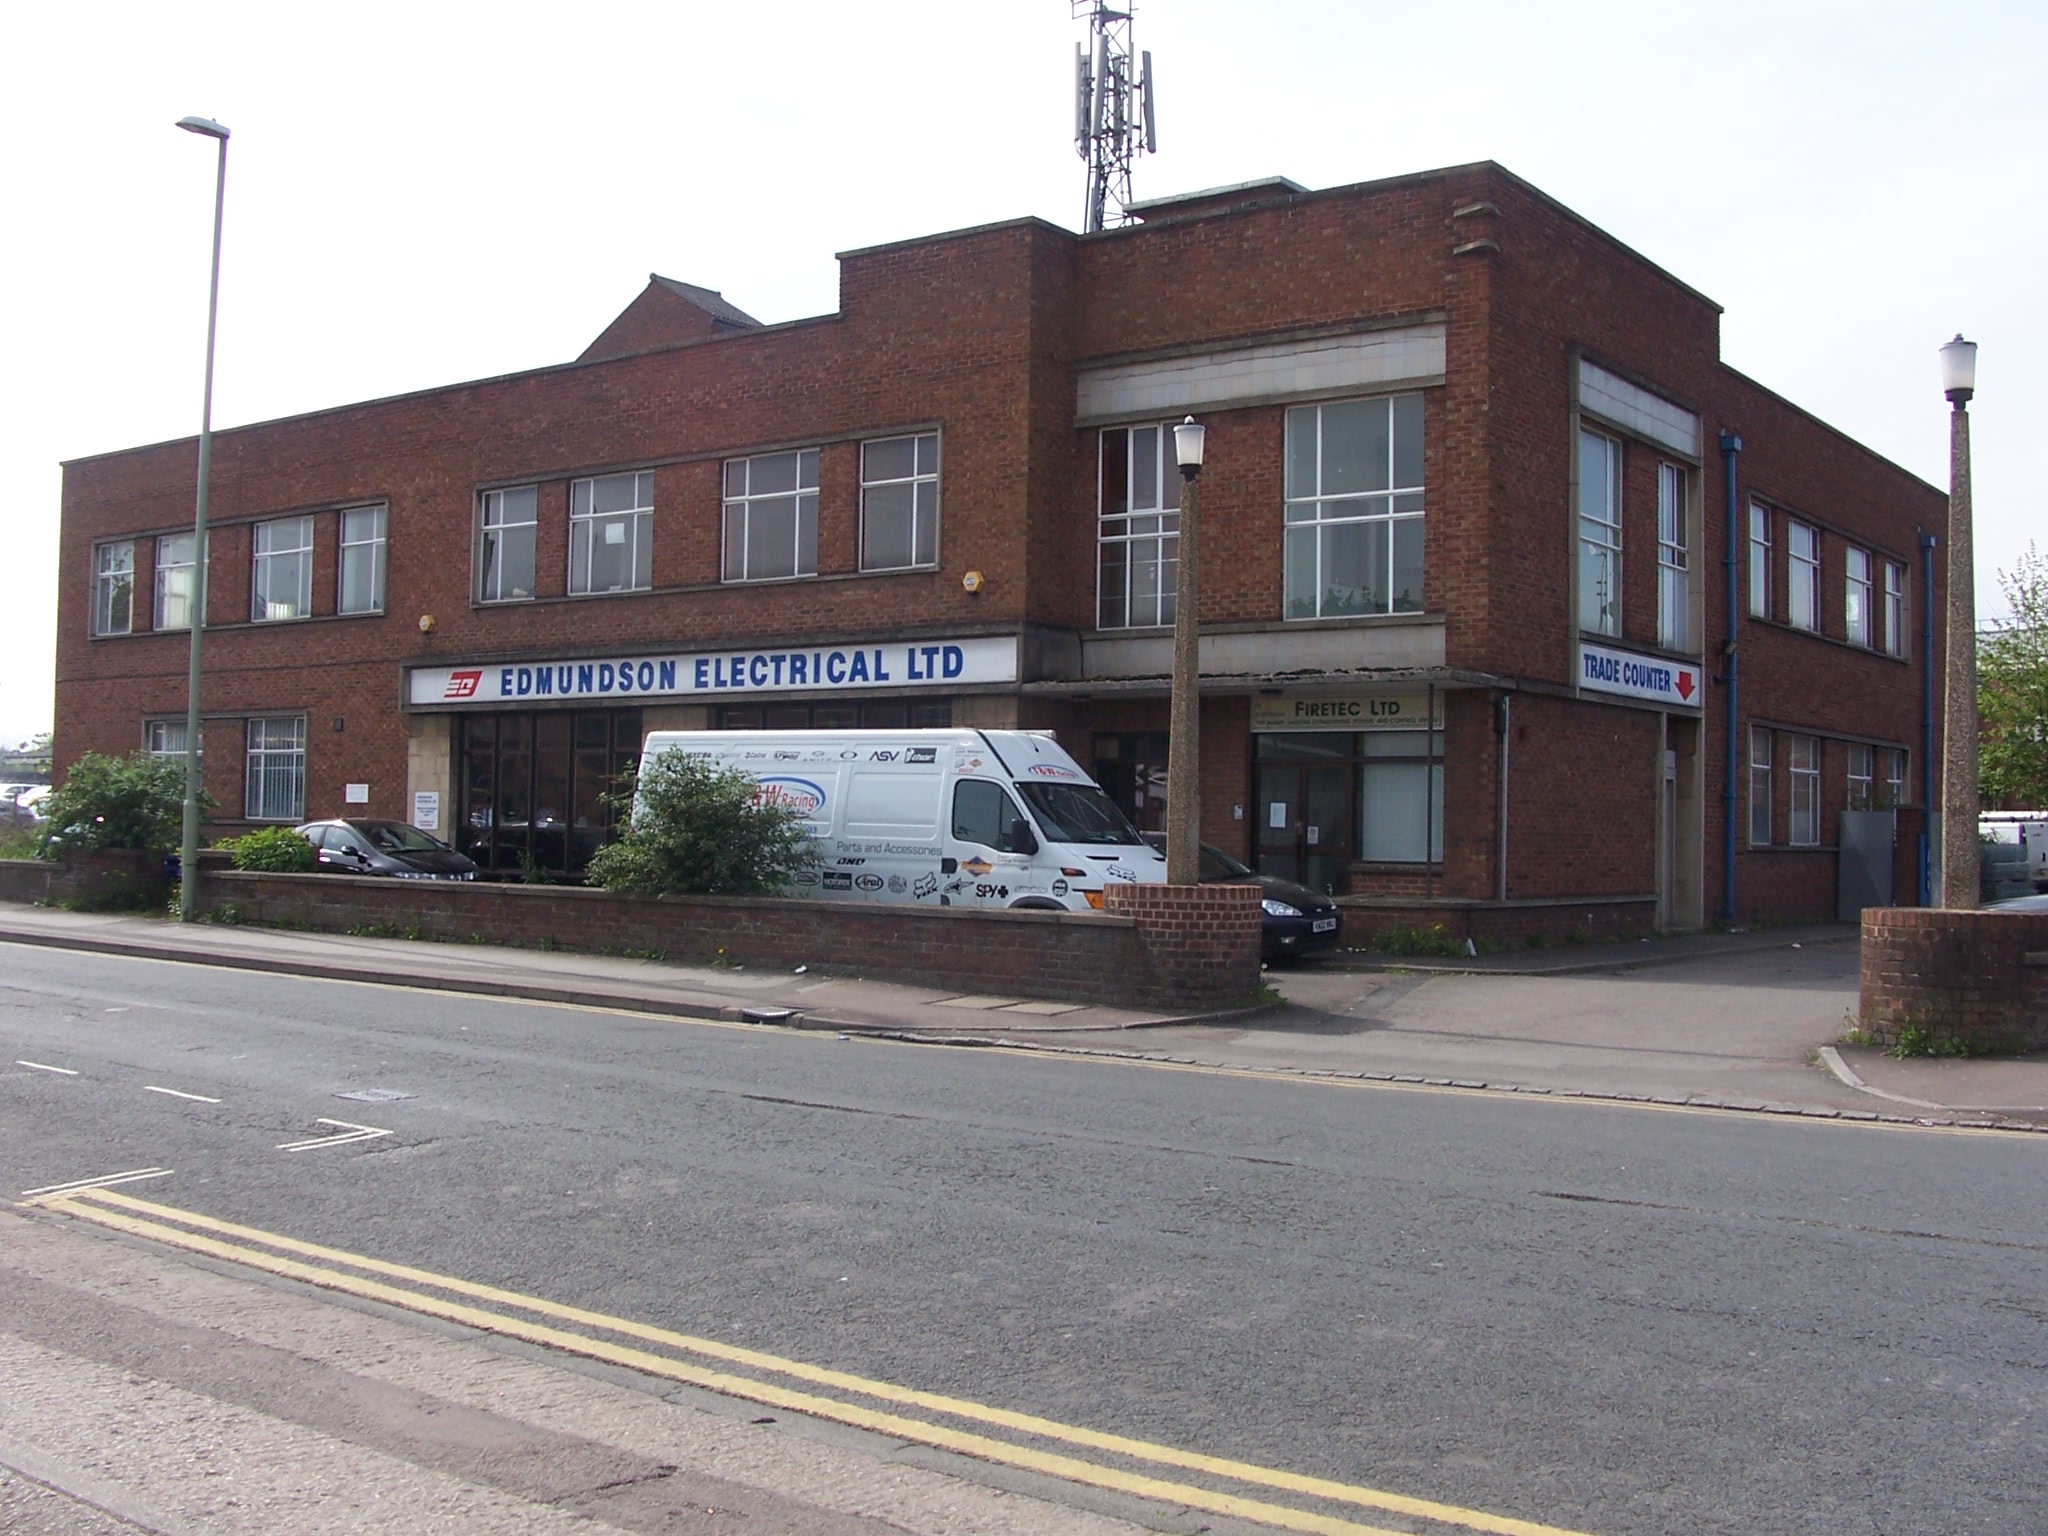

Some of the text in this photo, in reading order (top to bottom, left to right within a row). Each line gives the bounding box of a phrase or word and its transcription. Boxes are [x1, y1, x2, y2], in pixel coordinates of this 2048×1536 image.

[501, 645, 964, 696] EDMUNDSON ELECTRICAL LTD
[1583, 653, 1671, 693] TRADE COUNTER
[869, 751, 900, 762] ASV
[782, 792, 815, 812] Racing
[836, 840, 942, 856] Parts and Accessories
[976, 884, 998, 898] SPY
